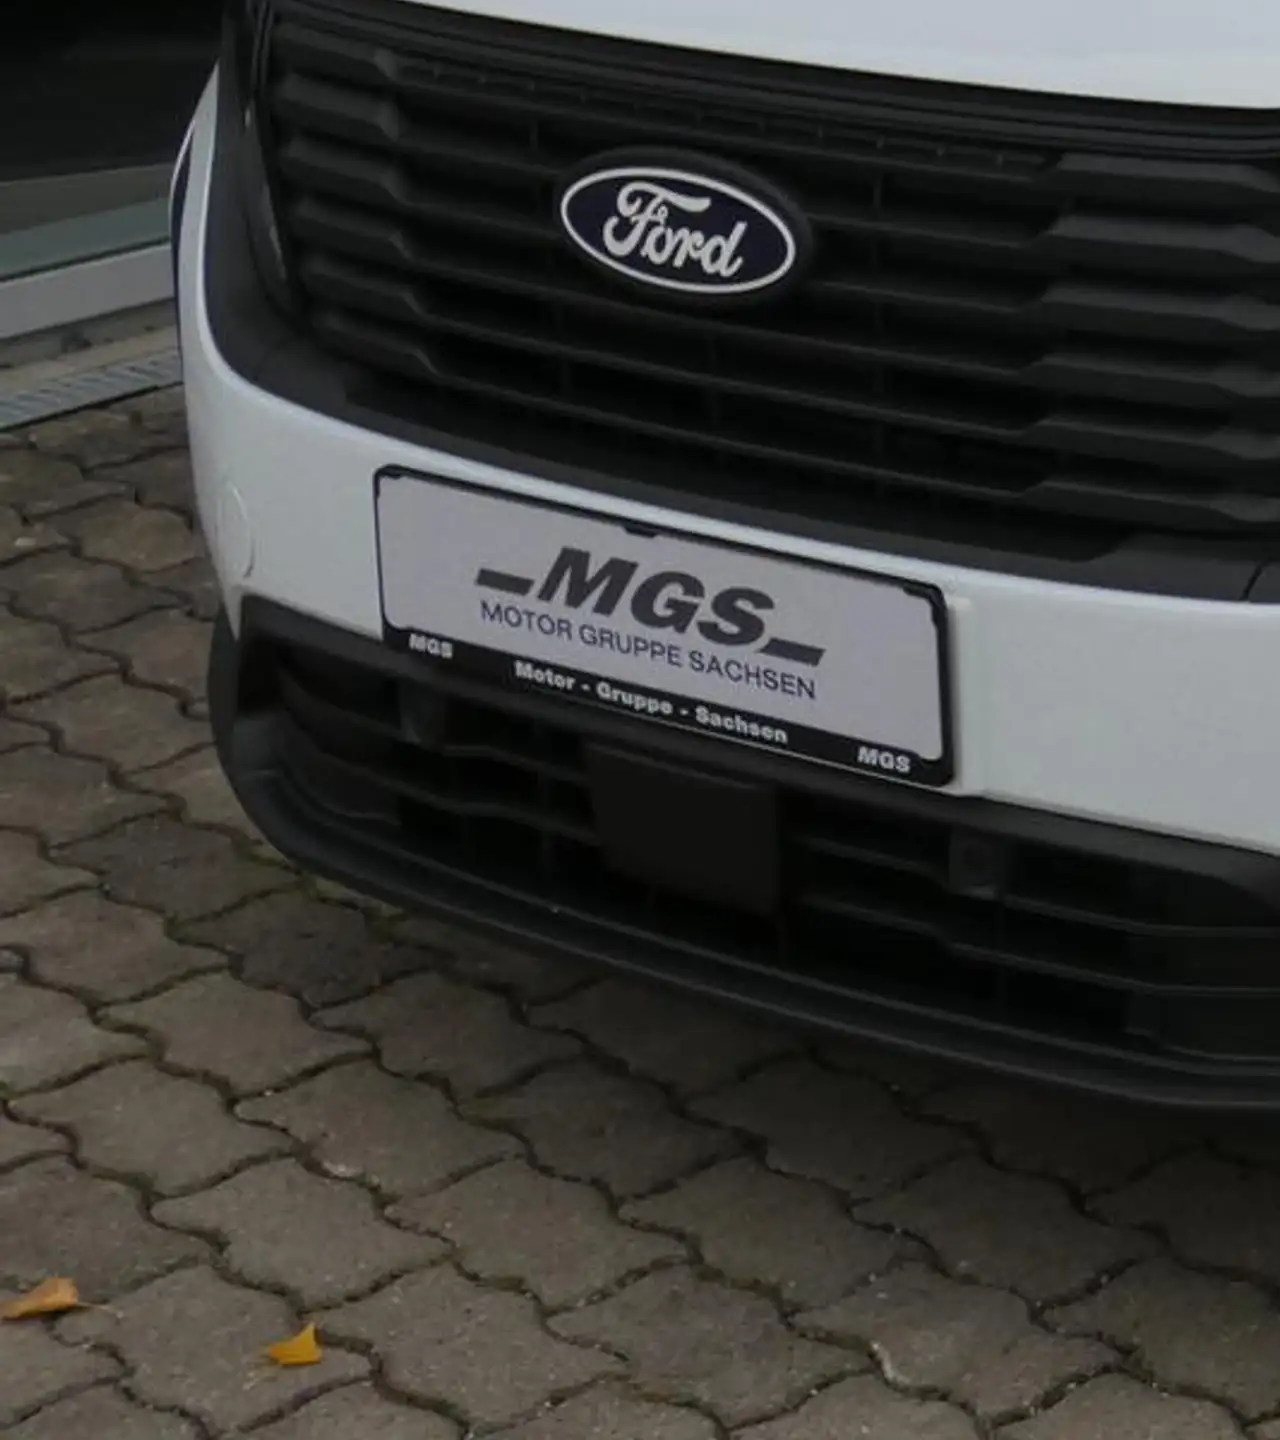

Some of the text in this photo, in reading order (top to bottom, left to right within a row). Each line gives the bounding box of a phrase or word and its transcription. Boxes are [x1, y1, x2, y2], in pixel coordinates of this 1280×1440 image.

[602, 180, 748, 278] Ford
[408, 633, 454, 659] MGS
[479, 600, 817, 701] MOTOR GRUPPE SACHSEN
[513, 661, 577, 691] Motor
[596, 681, 674, 715] Gruppe
[695, 705, 789, 745] Sachsen
[857, 745, 912, 774] MGS
